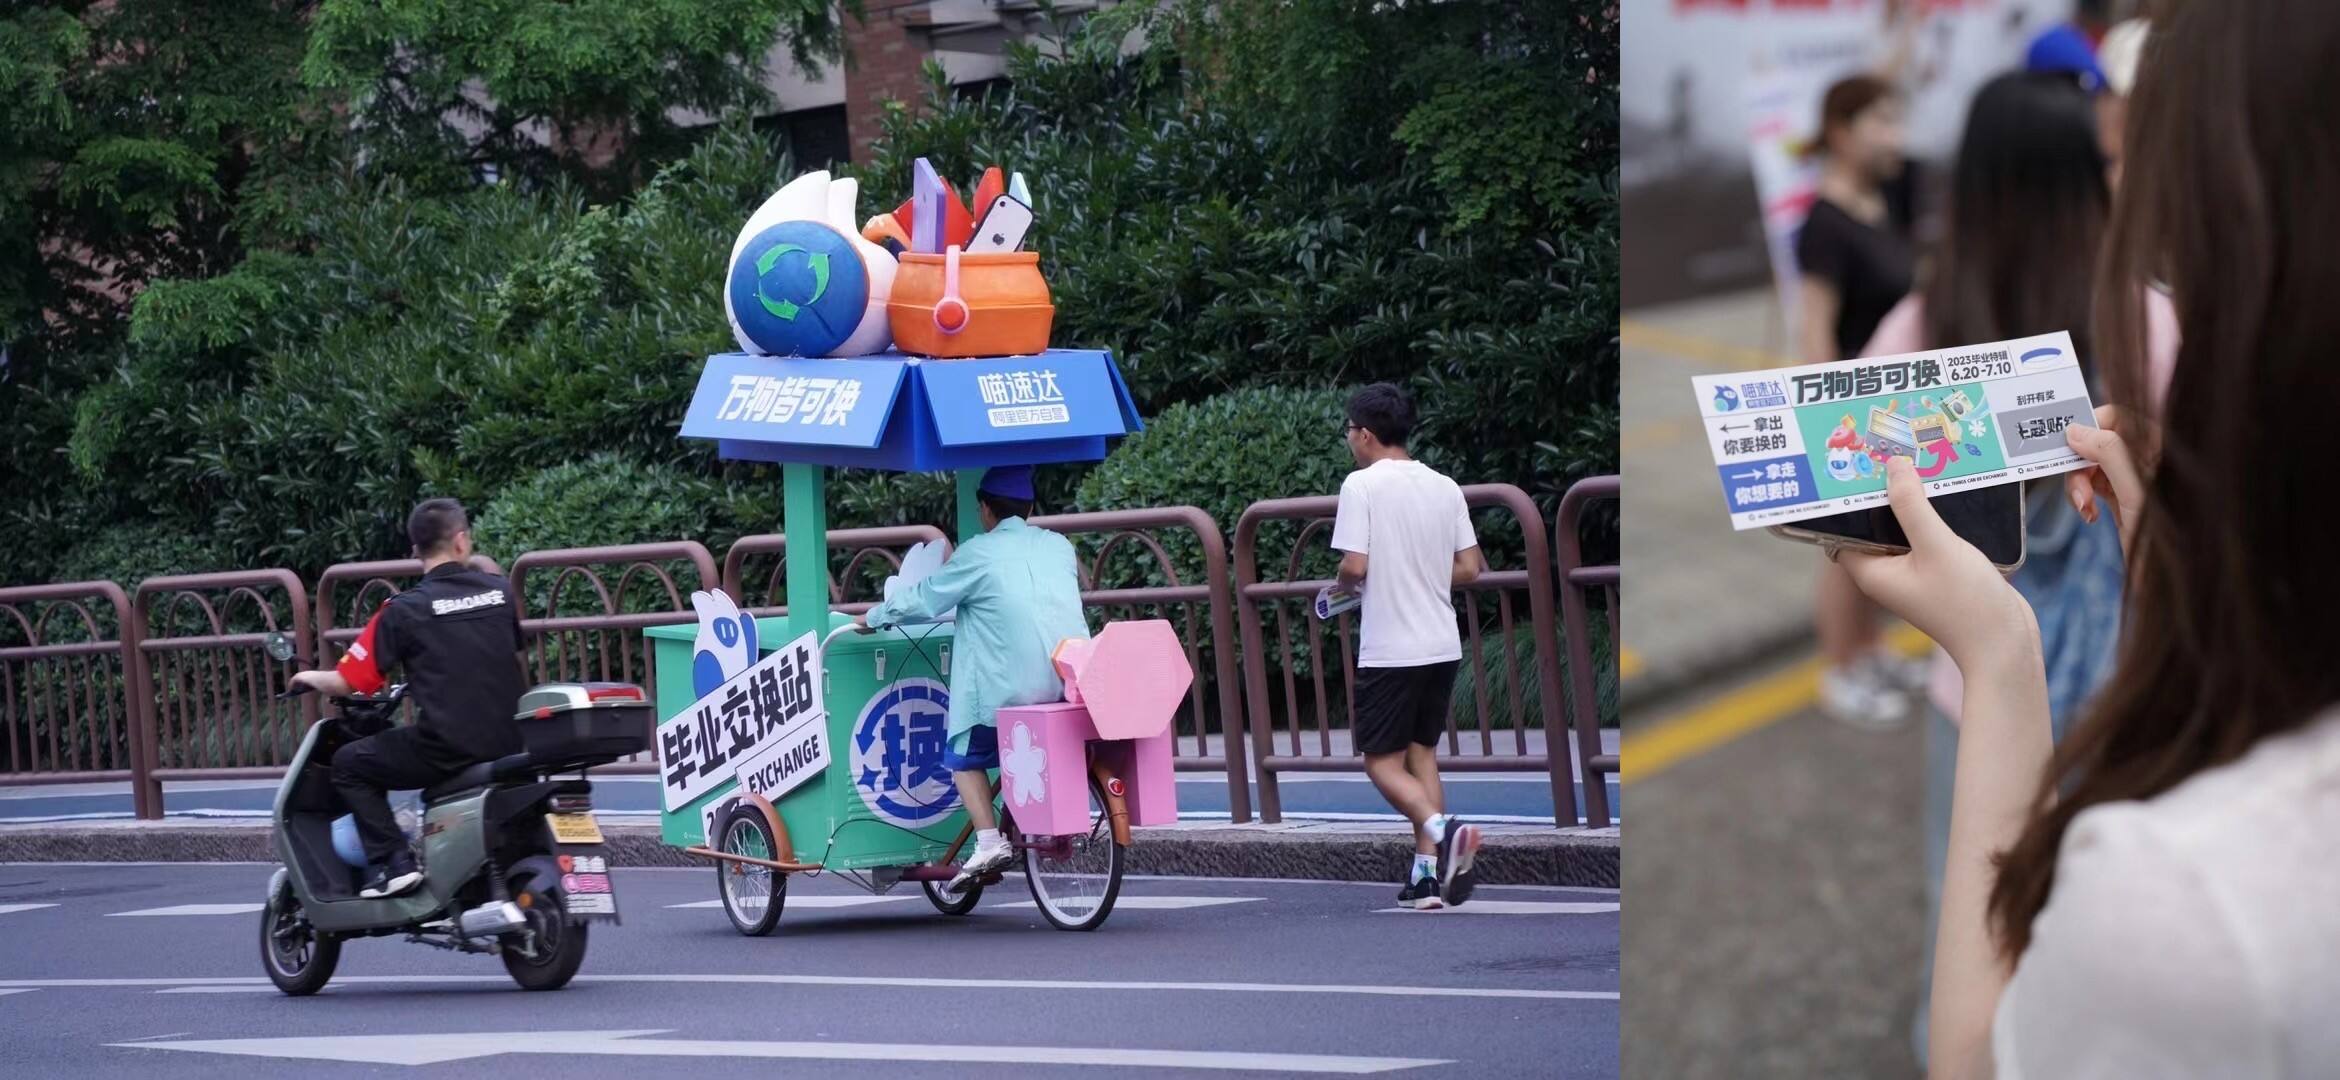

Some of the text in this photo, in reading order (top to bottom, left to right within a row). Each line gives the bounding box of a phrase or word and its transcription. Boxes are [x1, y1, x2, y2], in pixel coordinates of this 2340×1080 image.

[1791, 359, 1942, 404] 万物皆可换
[1951, 361, 2012, 381] 6.20-7.10
[977, 369, 1064, 405] 喵速达
[2016, 390, 2055, 406] 刮开有奖
[1754, 415, 1783, 432] 拿出
[1723, 432, 1786, 456] 你要换的
[1765, 461, 1797, 480] 拿走
[1734, 480, 1800, 506] 你想要的
[662, 645, 813, 791] 毕业交换站
[748, 733, 820, 795] EXCHANGE
[881, 712, 953, 791] 换
